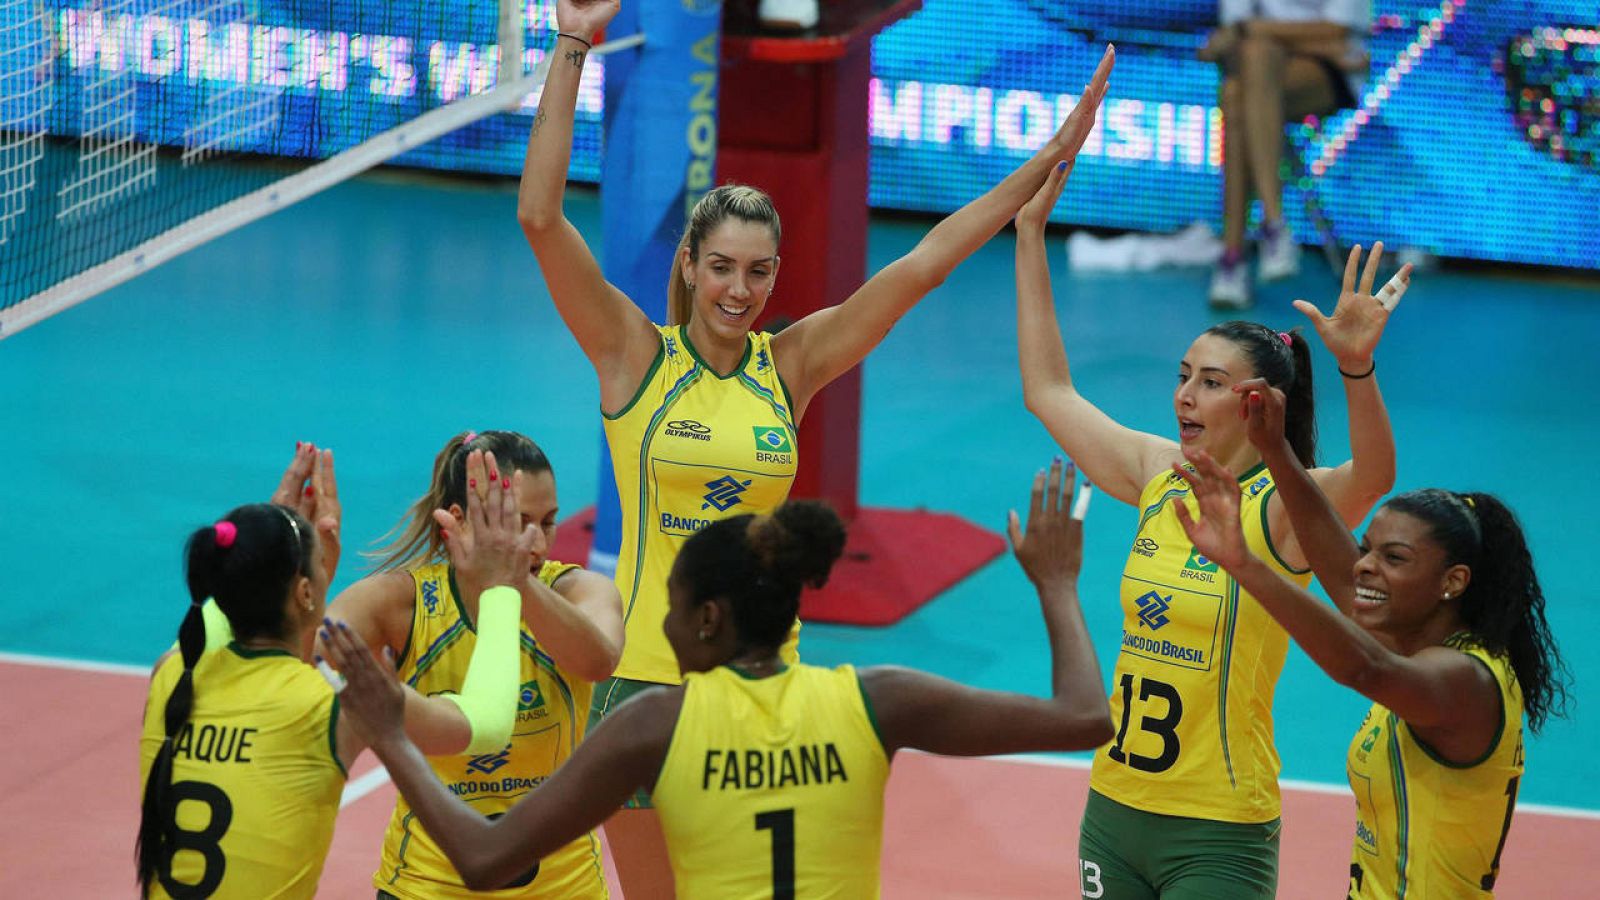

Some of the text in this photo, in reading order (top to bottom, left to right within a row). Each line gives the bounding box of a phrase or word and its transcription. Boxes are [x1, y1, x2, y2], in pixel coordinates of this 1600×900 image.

[60, 7, 416, 97] WOMEN'S
[664, 428, 712, 441] OLYMPIKUS
[756, 452, 793, 465] BRASIL
[1179, 569, 1215, 583] BRASIL
[1145, 638, 1161, 655] DO
[1161, 640, 1205, 664] BRASIL
[515, 708, 549, 723] RASIL
[1108, 673, 1183, 774] 13
[702, 743, 848, 790] FABIANA
[479, 781, 500, 793] DO
[501, 775, 545, 792] BRAS
[159, 780, 233, 900] 8
[754, 807, 796, 900] 1
